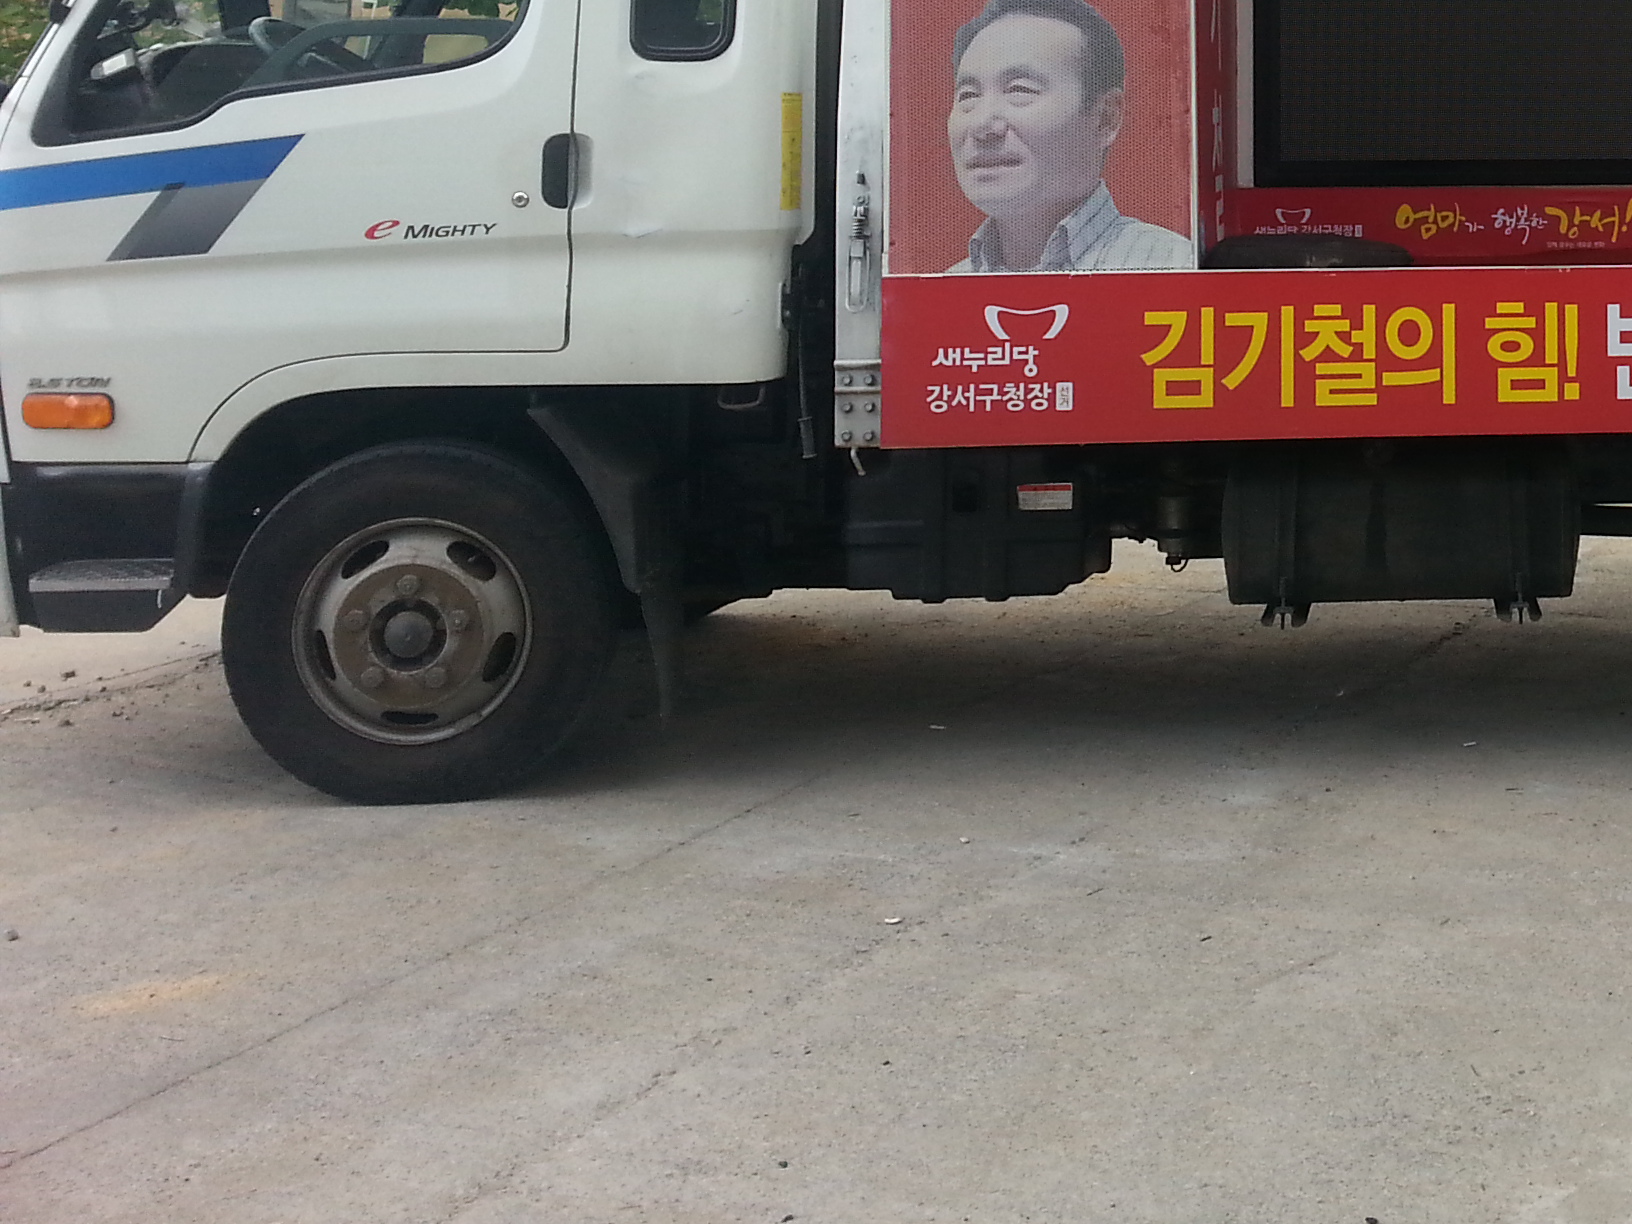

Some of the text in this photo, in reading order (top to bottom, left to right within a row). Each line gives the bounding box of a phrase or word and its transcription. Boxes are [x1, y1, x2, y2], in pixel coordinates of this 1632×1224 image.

[364, 219, 498, 240] e MIGHTY
[1491, 204, 1547, 245] 행복한
[932, 342, 1039, 377] 새누리당
[1140, 304, 1457, 410] 김기철의
[1485, 301, 1581, 404] 힘!
[926, 382, 1052, 413] 강서구청장
